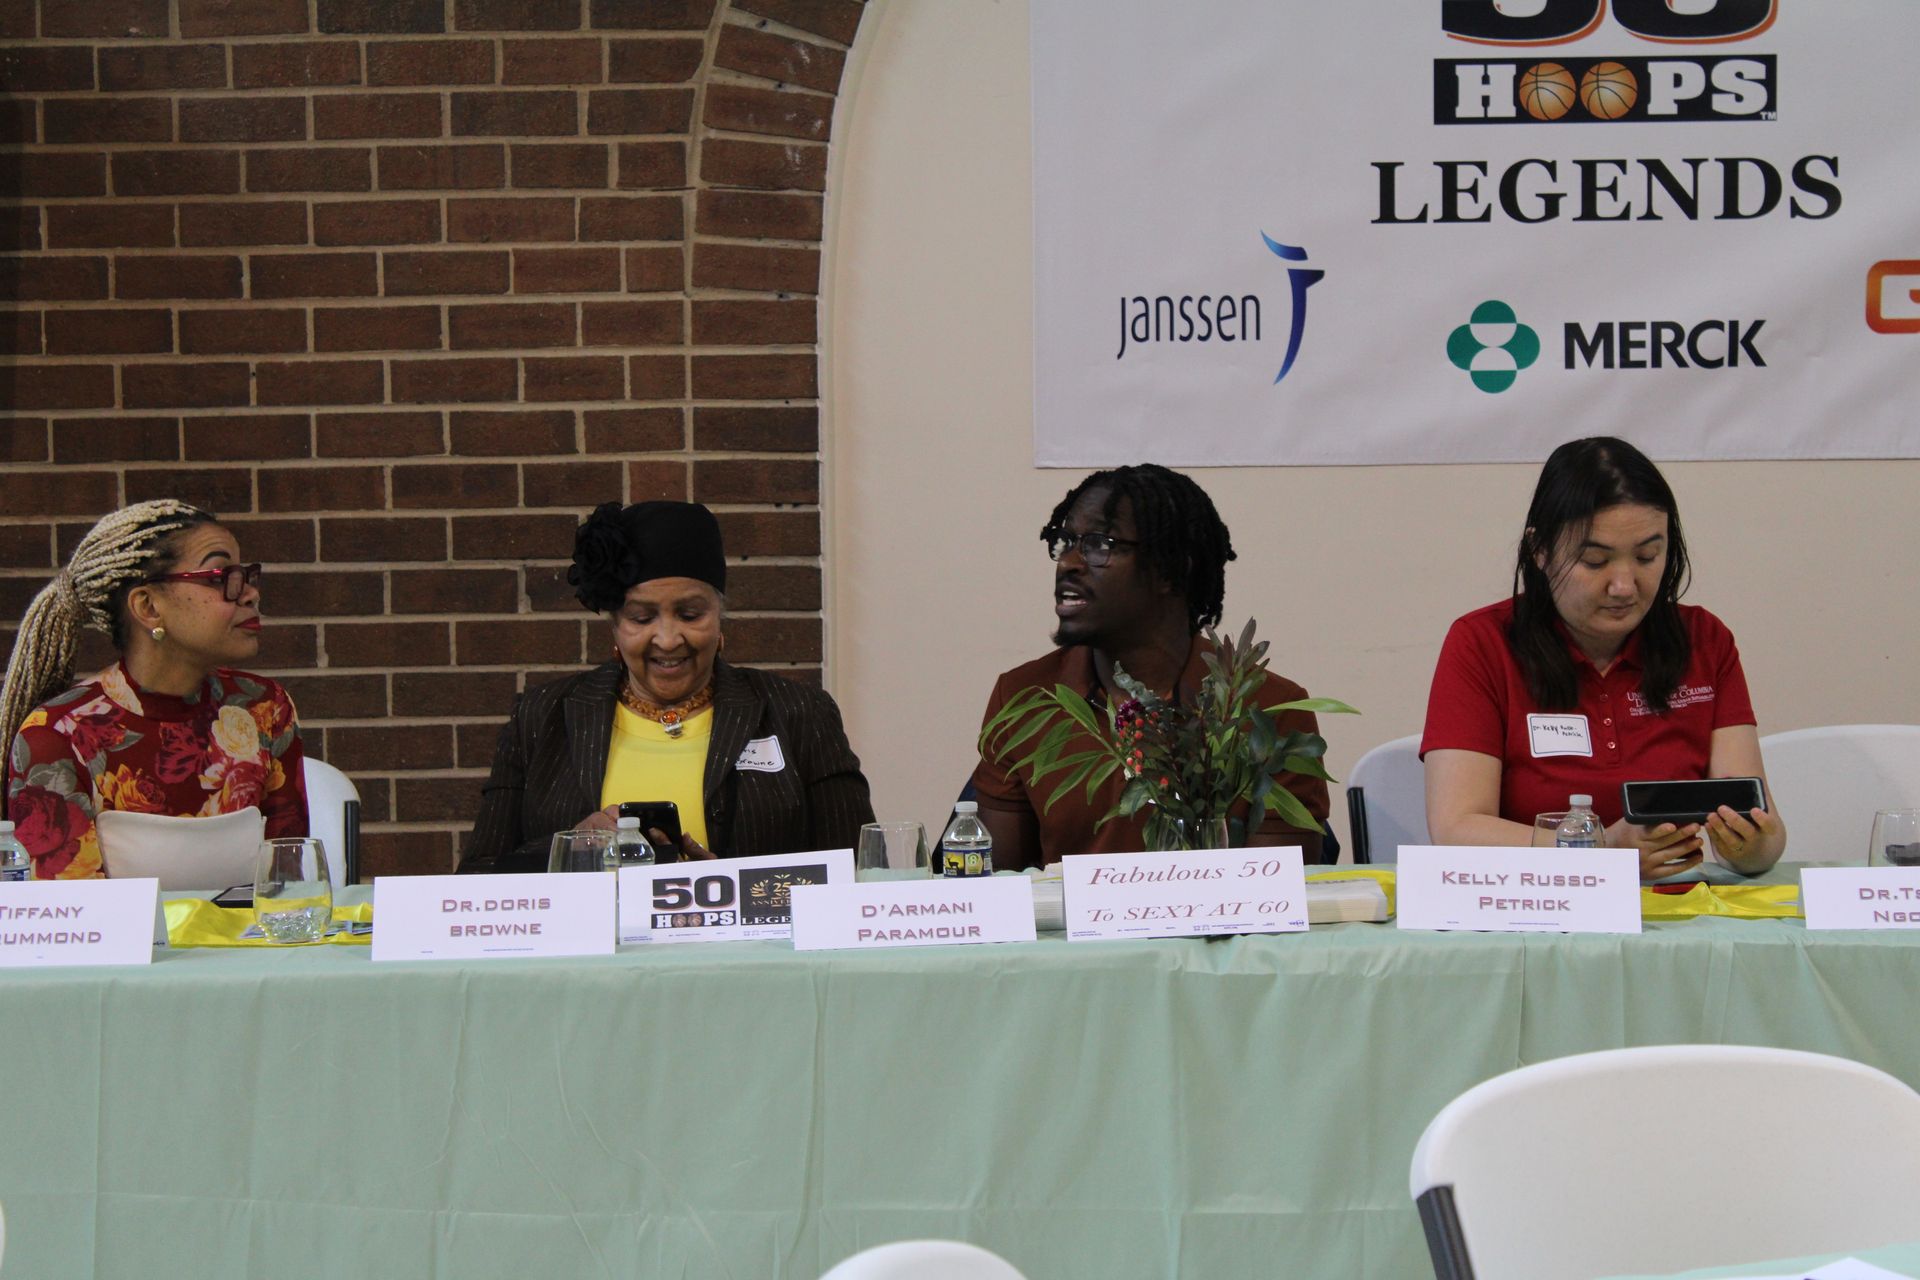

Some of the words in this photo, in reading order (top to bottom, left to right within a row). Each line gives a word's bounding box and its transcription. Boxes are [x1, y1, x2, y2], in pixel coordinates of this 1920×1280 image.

[1455, 59, 1768, 120] HOOPS
[1371, 155, 1842, 224] LEGENDS
[1564, 319, 1768, 369] MERCK
[1087, 864, 1226, 886] Fabulous
[1237, 860, 1282, 879] 50
[1442, 871, 1509, 886] KELLY
[1520, 872, 1606, 888] RUSSO-
[652, 875, 737, 912] 50
[862, 902, 974, 918] D'ARMANI
[1087, 908, 1115, 922] To
[1123, 904, 1203, 921] SEXY
[1208, 901, 1252, 917] AT
[1258, 900, 1290, 914] 60
[1479, 896, 1571, 911] PETRICK
[0, 906, 84, 919] TIFFANY
[656, 911, 735, 929] HOOPS
[0, 931, 102, 945] UMMOND
[450, 923, 543, 938] BROWNE
[858, 926, 981, 941] PARAMOUR
